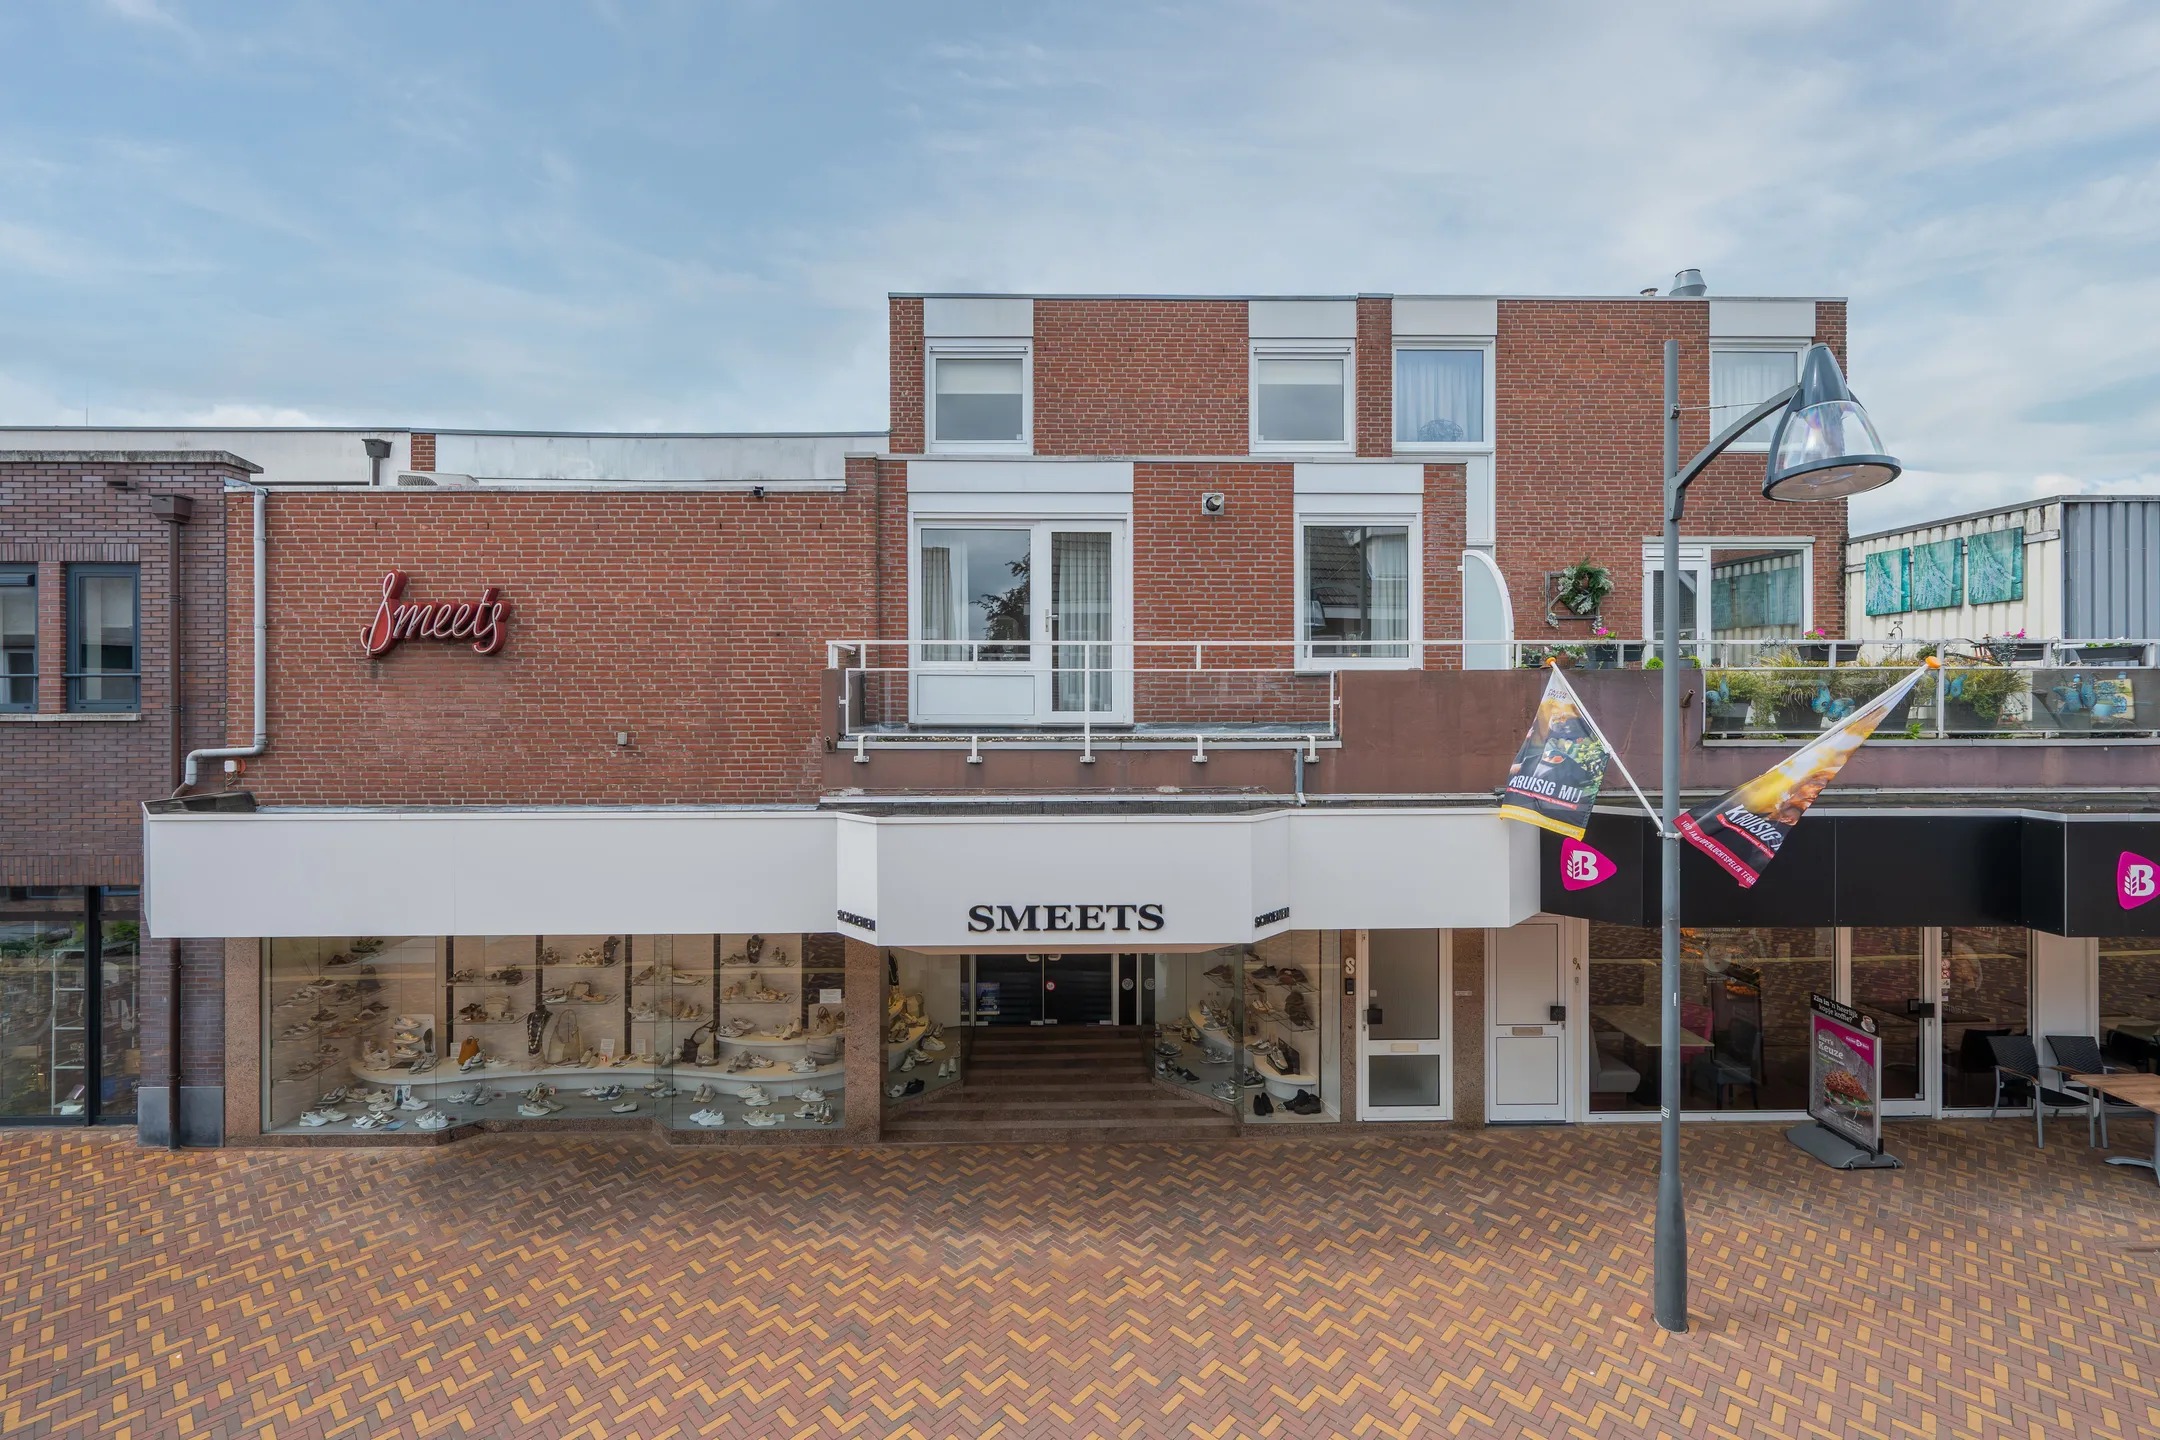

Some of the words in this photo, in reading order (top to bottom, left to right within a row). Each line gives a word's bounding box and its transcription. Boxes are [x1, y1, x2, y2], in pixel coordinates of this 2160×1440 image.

[361, 569, 510, 657] Smeets
[1558, 785, 1583, 803] MIJ
[1681, 820, 1692, 830] 100
[1725, 804, 1782, 842] KRUISIG
[968, 904, 1165, 932] SMEETS
[1818, 1040, 1844, 1060] Keuze
